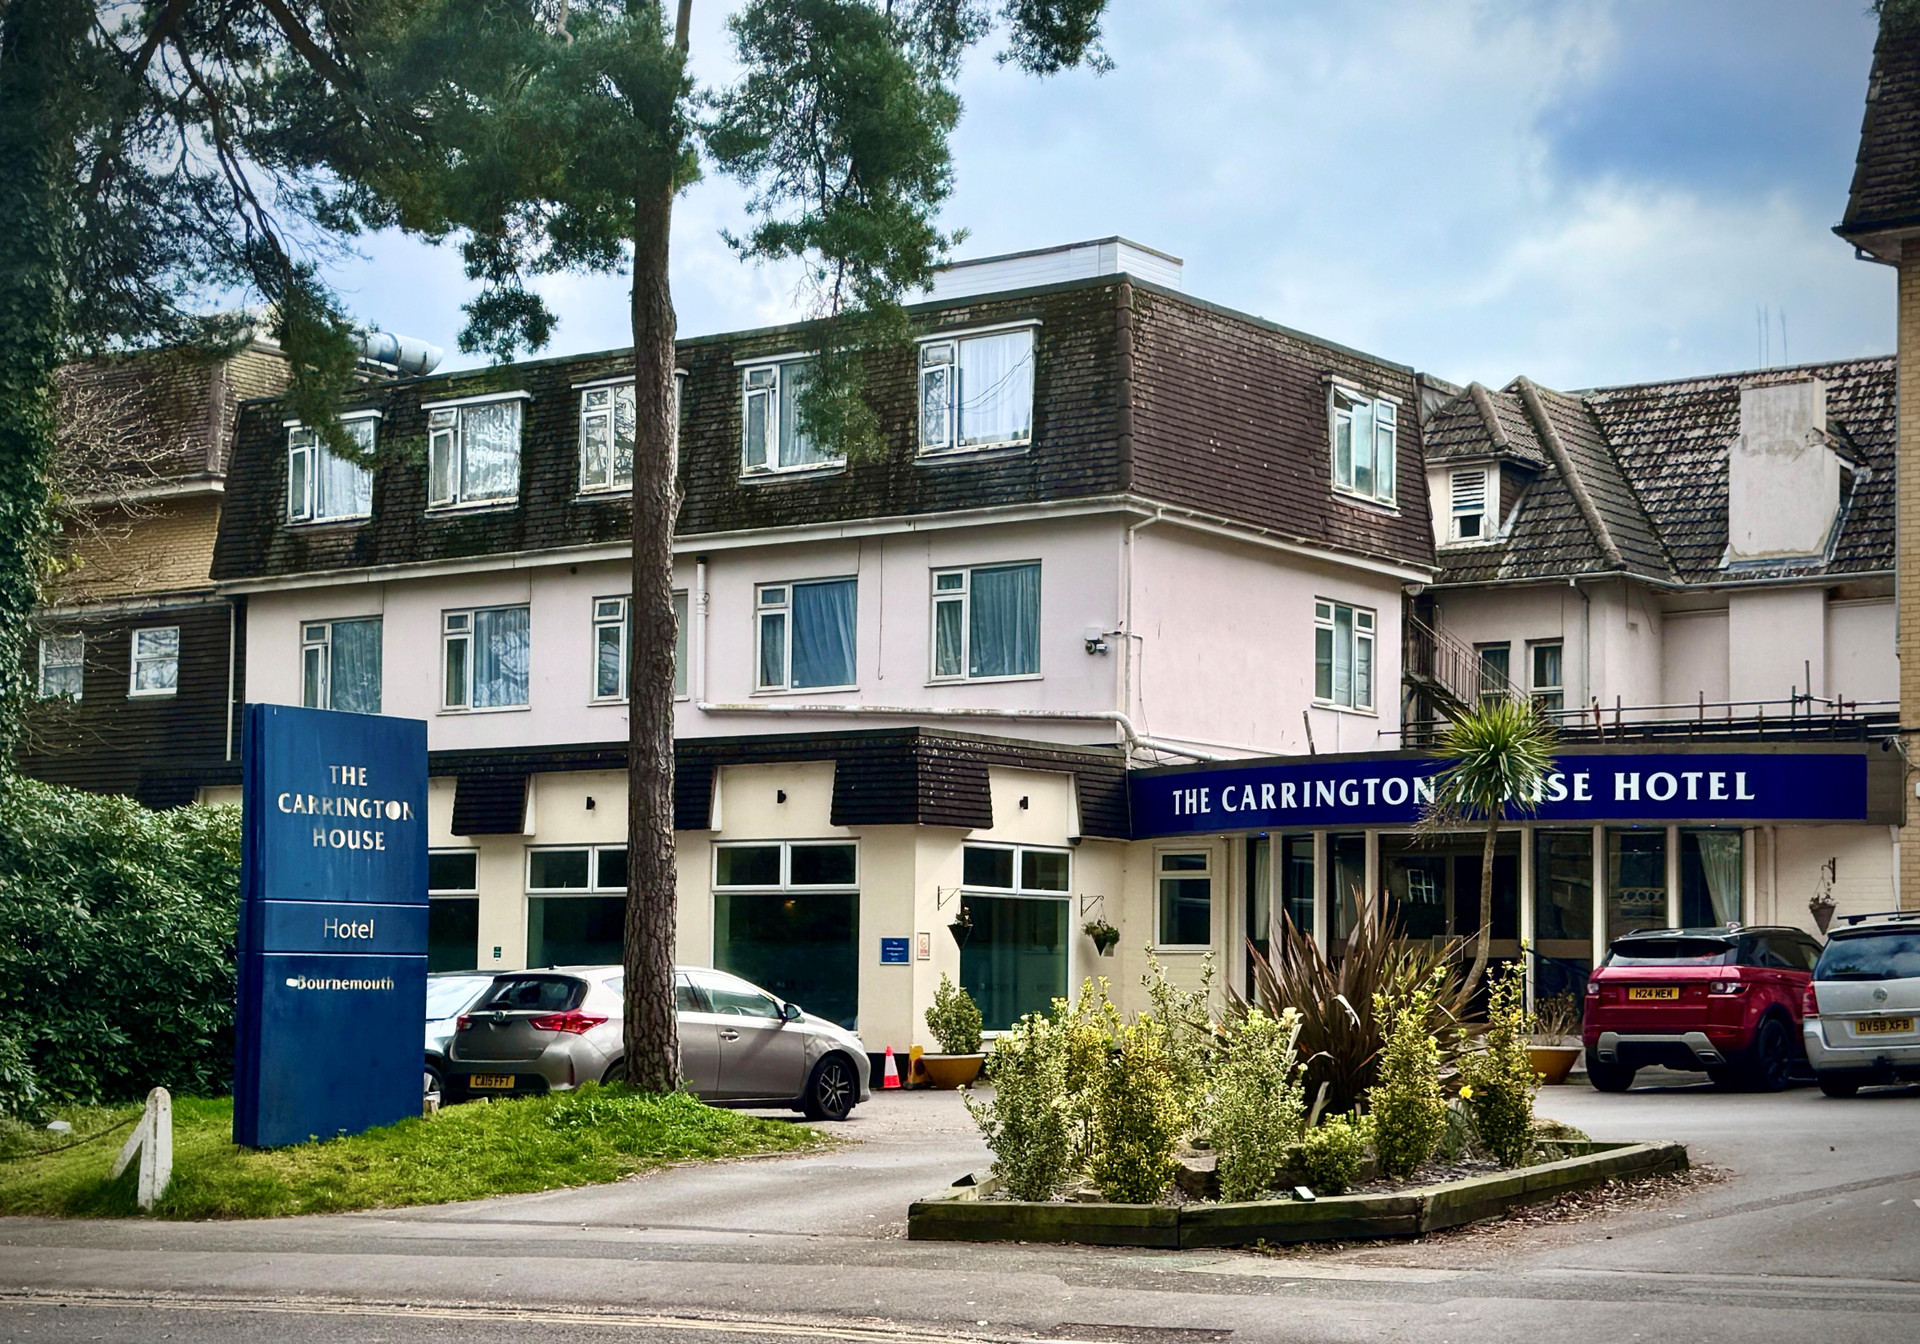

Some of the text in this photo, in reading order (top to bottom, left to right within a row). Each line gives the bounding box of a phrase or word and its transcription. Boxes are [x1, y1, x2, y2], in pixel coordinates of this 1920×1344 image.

[329, 765, 368, 787] THE
[1172, 787, 1211, 815] THE
[1221, 776, 1436, 813] CARRINGTON
[1614, 771, 1756, 801] HOTEL
[277, 792, 416, 821] CARRINGTON
[312, 827, 387, 851] HOUSE
[323, 917, 375, 939] Hotel
[296, 974, 395, 991] Bournemouth
[1859, 1020, 1886, 1032] DV58
